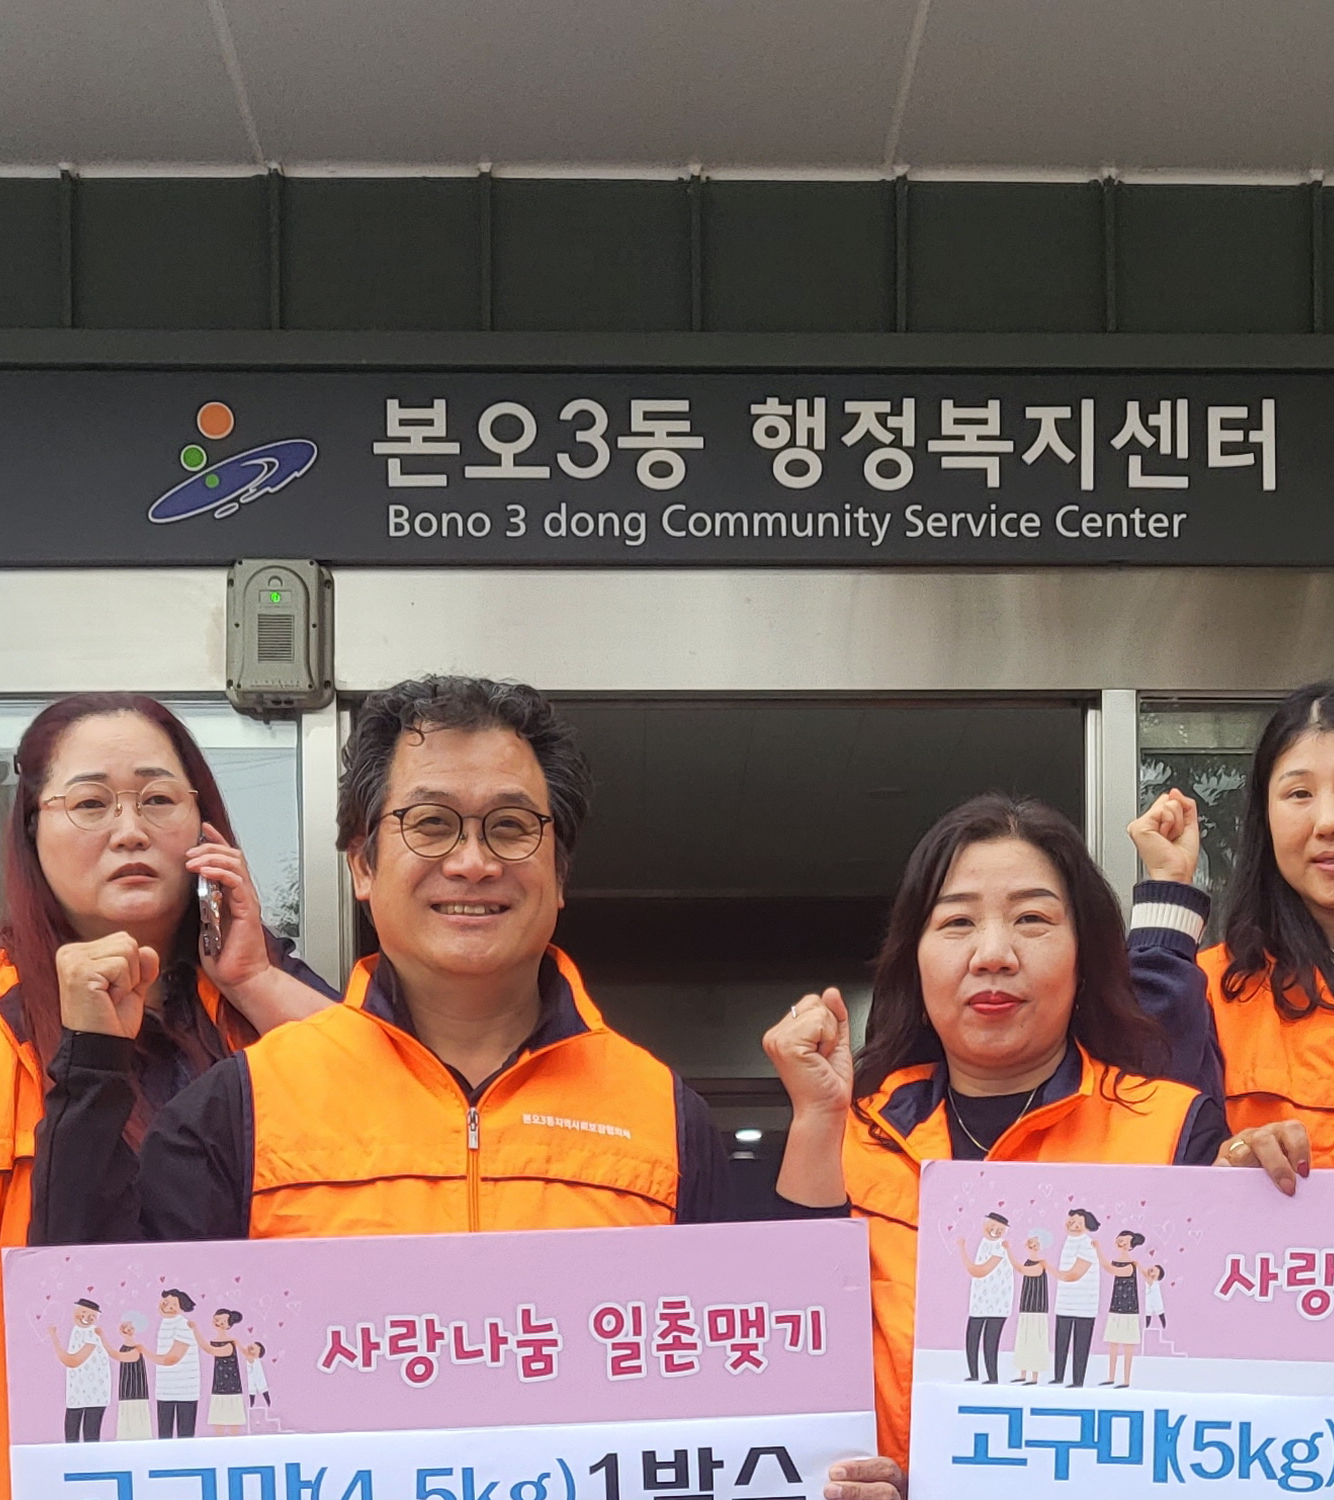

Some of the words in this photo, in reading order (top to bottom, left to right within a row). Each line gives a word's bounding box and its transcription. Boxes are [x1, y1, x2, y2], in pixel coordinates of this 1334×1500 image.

[372, 396, 706, 490] 본오3동
[750, 396, 1279, 494] 행정복지센터
[386, 505, 491, 539] Bono
[505, 505, 526, 539] 3
[542, 502, 648, 547] dong
[660, 502, 892, 547] Community
[904, 502, 1041, 539] Service
[1053, 502, 1187, 539] Center
[322, 1309, 563, 1382] 사랑나눔
[593, 1299, 824, 1376] 일촌맺기
